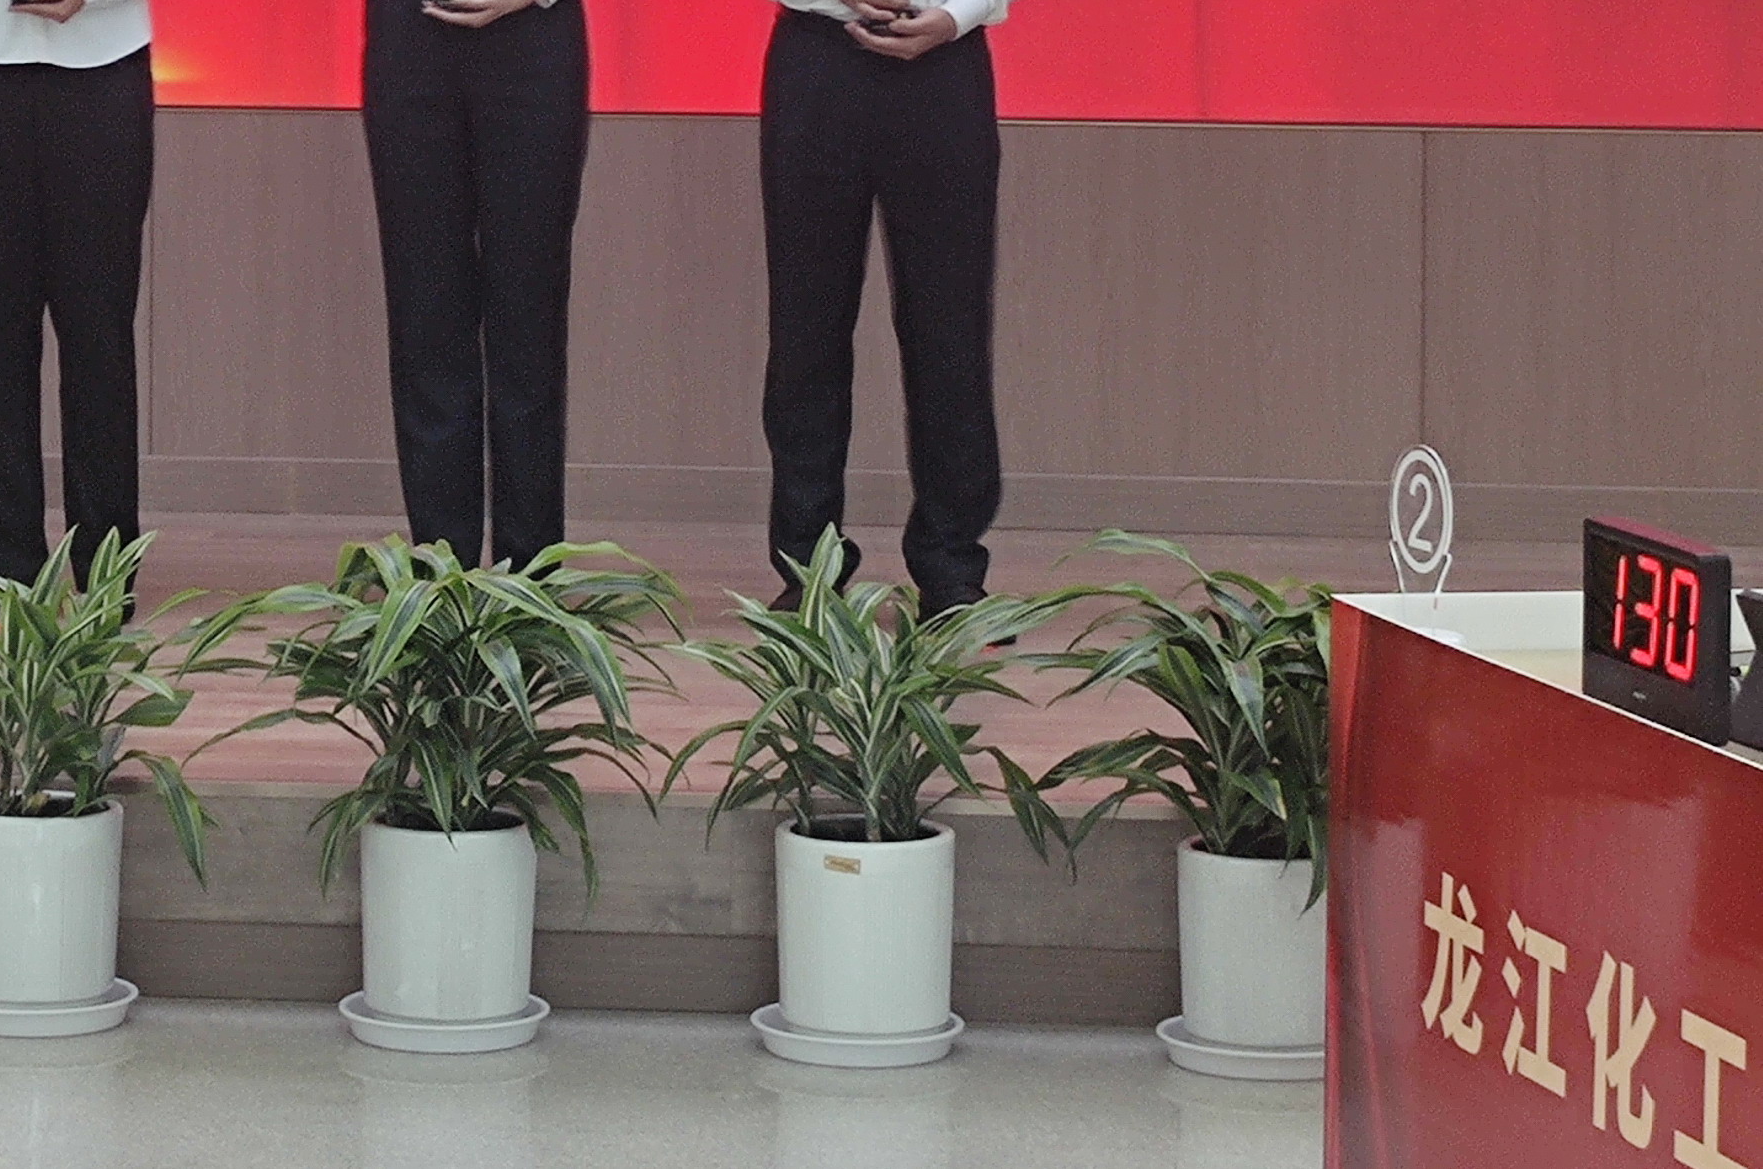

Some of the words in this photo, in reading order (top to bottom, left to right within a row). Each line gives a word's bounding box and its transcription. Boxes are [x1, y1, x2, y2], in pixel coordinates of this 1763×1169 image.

[1611, 553, 1702, 685] 130
[1420, 870, 1763, 1169] 龙江化工
